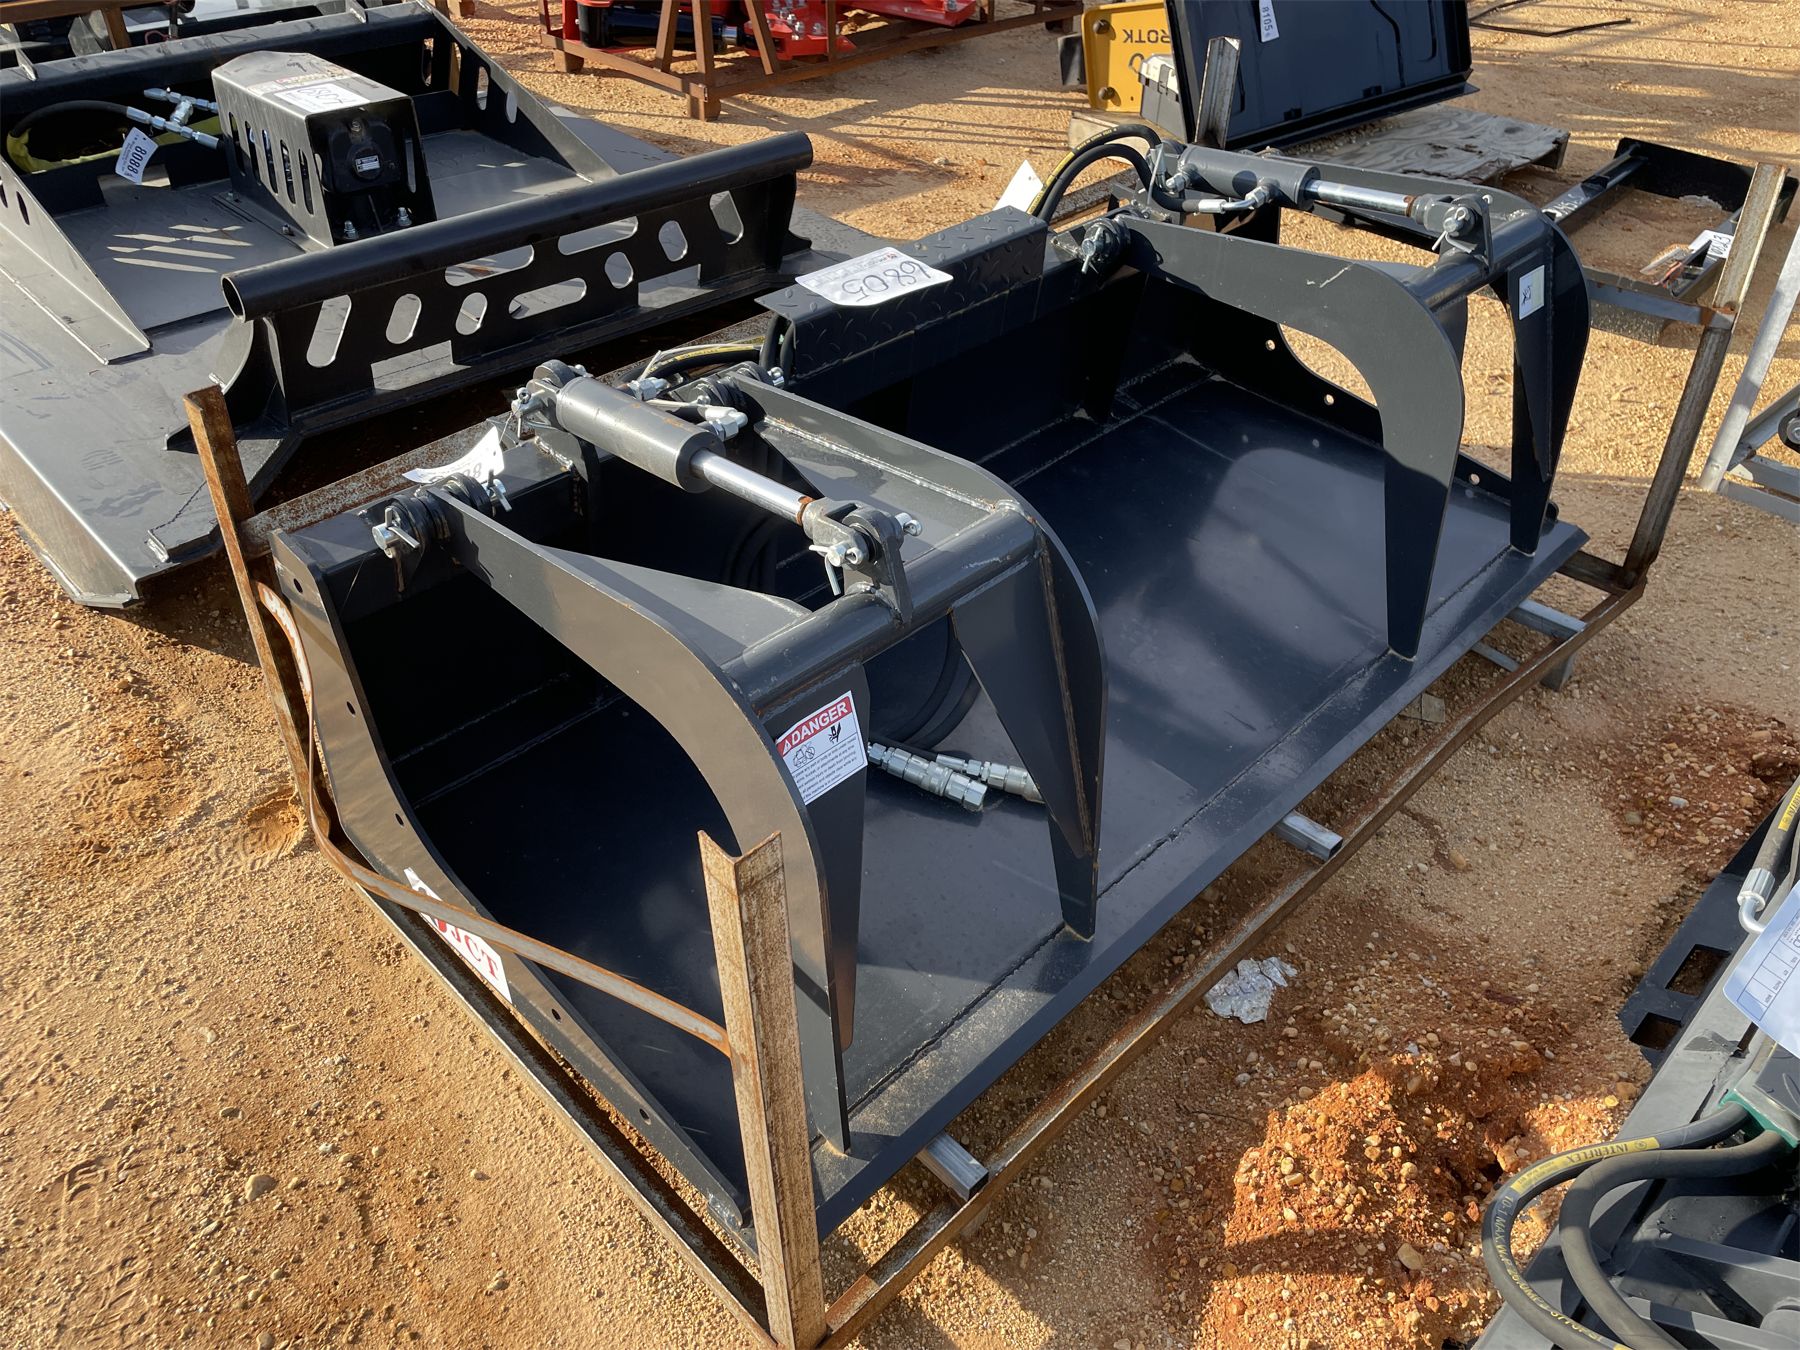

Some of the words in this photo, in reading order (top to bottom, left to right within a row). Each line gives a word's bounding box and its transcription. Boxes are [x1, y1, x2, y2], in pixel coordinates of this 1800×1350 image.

[1262, 6, 1274, 32] 8105
[791, 700, 848, 746] DANGER
[1567, 1143, 1629, 1164] INTERFLEX
